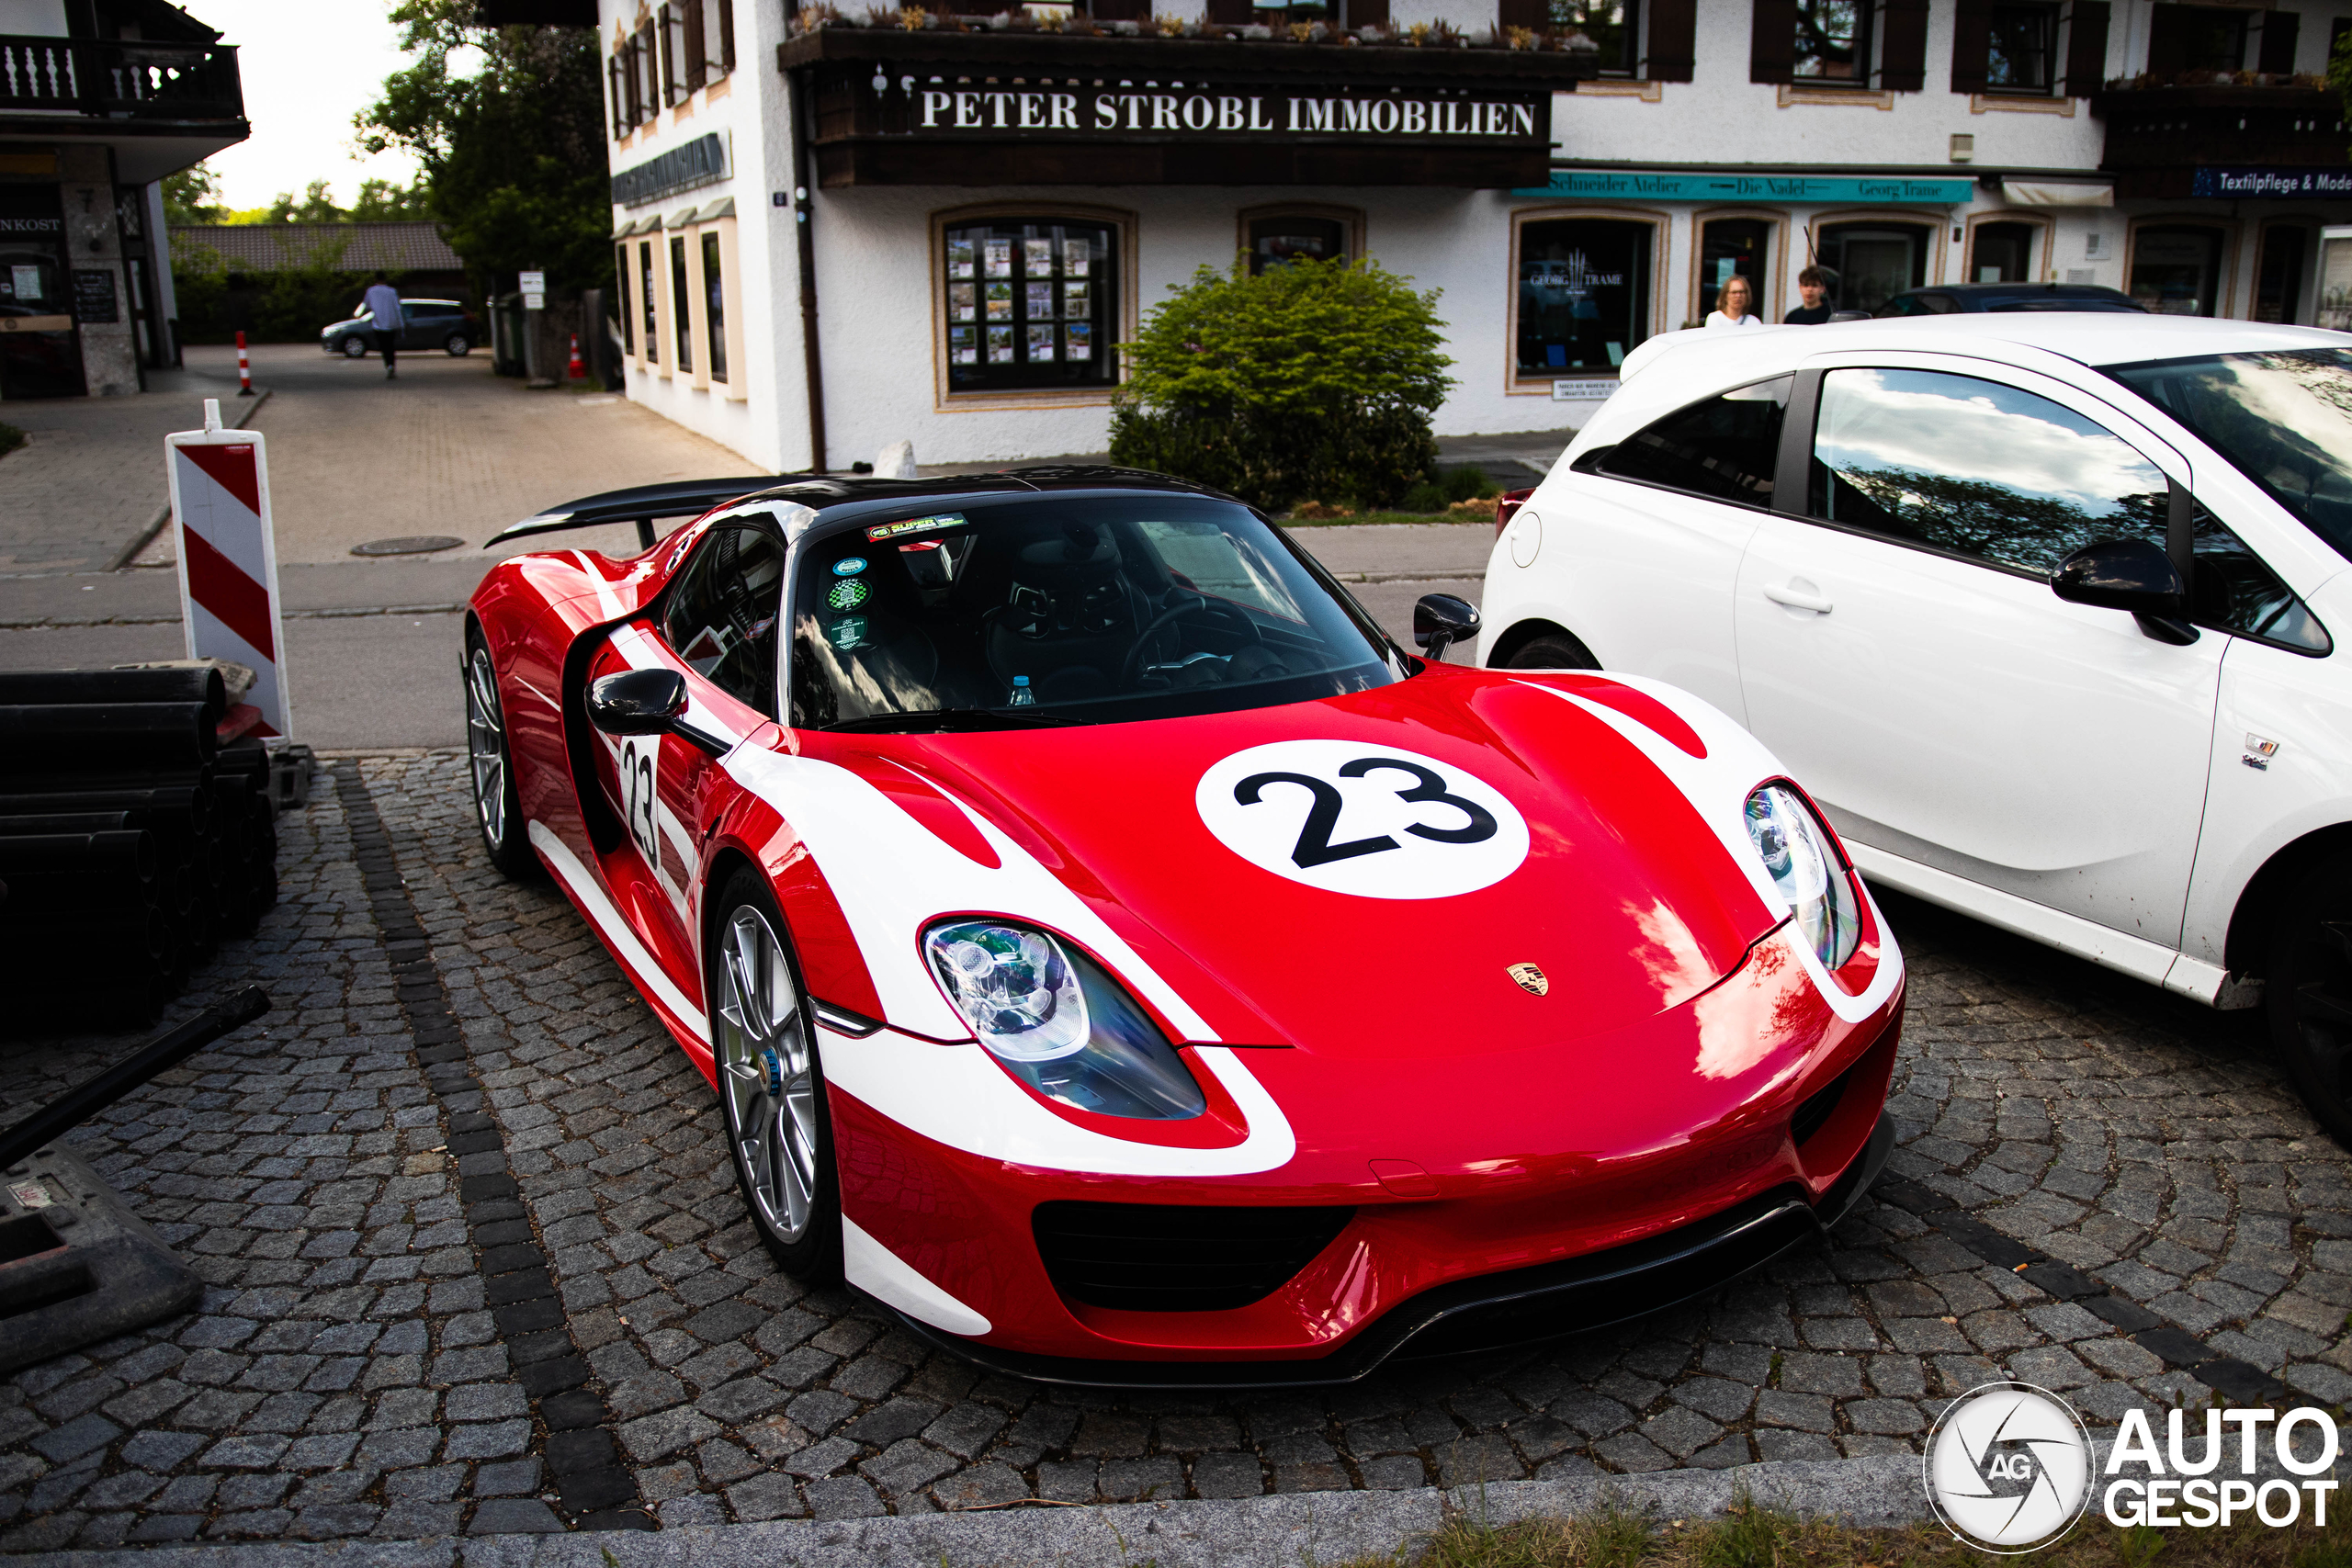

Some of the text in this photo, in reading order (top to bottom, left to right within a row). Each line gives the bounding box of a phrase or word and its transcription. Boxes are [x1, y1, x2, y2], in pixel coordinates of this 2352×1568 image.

[921, 91, 1537, 136] PETER STROBL IMMOBILIEN
[1549, 175, 1681, 194] Schneider Atelier
[1736, 177, 1805, 196] Die Nadel
[1858, 179, 1942, 200] Georg Trame
[2220, 173, 2299, 195] Textilpflege
[2301, 174, 2312, 191] &
[1530, 274, 1623, 287] GEORG TRAME
[623, 739, 658, 871] 23
[1234, 758, 1498, 869] 23
